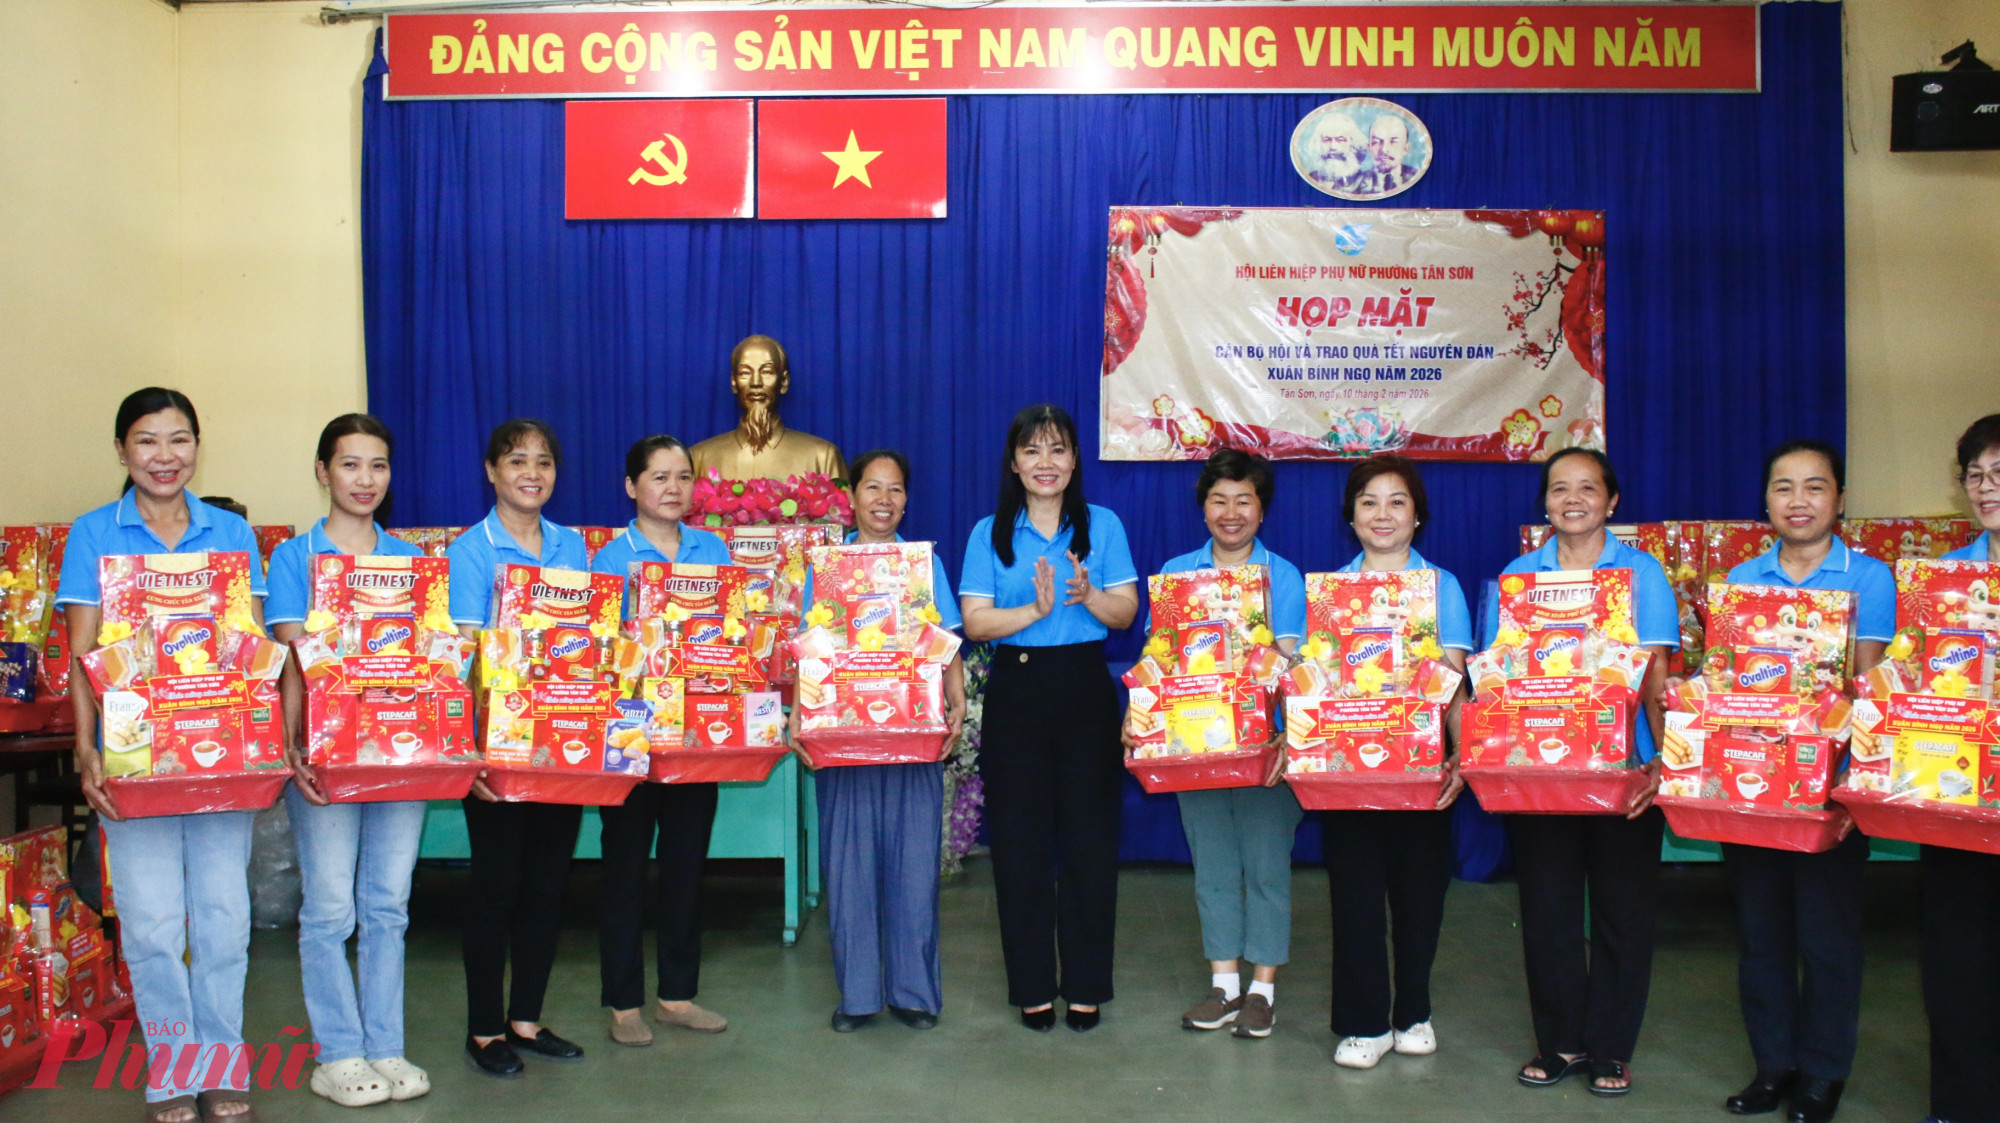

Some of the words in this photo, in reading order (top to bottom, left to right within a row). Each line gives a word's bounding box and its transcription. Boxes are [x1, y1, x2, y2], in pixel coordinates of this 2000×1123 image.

[429, 19, 564, 74] ĐẢNG
[580, 23, 717, 85] CỘNG
[733, 15, 831, 72] SẢN
[848, 20, 963, 81] VIỆT
[979, 27, 1086, 68] NAM
[1103, 26, 1278, 71] QUANG
[1294, 26, 1415, 67] VINH
[1432, 16, 1576, 67] MUÔN
[1593, 17, 1701, 67] NĂM
[1236, 263, 1255, 281] HỘI
[1259, 264, 1286, 279] LIÊN
[1290, 263, 1317, 281] HIỆP
[1320, 265, 1345, 281] PHỤ
[1349, 263, 1366, 279] NỮ
[1369, 263, 1418, 280] PHƯỜNG
[1422, 264, 1445, 280] TÂN
[1448, 264, 1474, 280] SƠN
[1275, 296, 1351, 336] HỌP
[1357, 286, 1436, 336] MẶT
[1215, 342, 1242, 358] CÁN
[1247, 343, 1264, 361] BỘ
[1268, 343, 1291, 361] HỘI
[1295, 343, 1311, 358] VÀ
[1316, 346, 1348, 358] TRAO
[1353, 343, 1379, 360] QUÀ
[1384, 342, 1405, 358] TẾT
[1410, 344, 1462, 358] NGUYÊN
[1466, 343, 1494, 358] ĐÁN
[1267, 364, 1303, 380] XUÂN
[1308, 365, 1339, 380] BÍNH
[1344, 368, 1371, 383] NGỌ
[1375, 365, 1406, 380] NĂM
[1410, 368, 1442, 380] 2026
[1344, 388, 1353, 398] 10
[1381, 388, 1386, 398] 2
[1410, 388, 1429, 398] 2026
[729, 541, 781, 551] VIETNEST
[137, 571, 217, 589] VIETNEST
[347, 574, 418, 588] VIETNEST
[665, 579, 723, 593] VIETNEST
[531, 584, 596, 602] VIETNEST
[852, 606, 893, 630] Ovaltine
[163, 628, 211, 656] Ovaltine
[367, 626, 411, 653] Ovaltine
[690, 625, 722, 643] Ovaltine
[551, 635, 590, 658] Ovaltine
[1347, 639, 1389, 665] Ovaltine
[1738, 662, 1787, 688] Ovaltine
[377, 711, 417, 720] STEPACAFE
[697, 703, 728, 712] STEPACAFE
[174, 718, 220, 731] STEPACAFE
[552, 719, 588, 730] STEPACAFE
[1525, 717, 1565, 727] STEPACAFE
[1723, 748, 1766, 761] STEPACAFE
[1914, 741, 1958, 754] STEPACAFE
